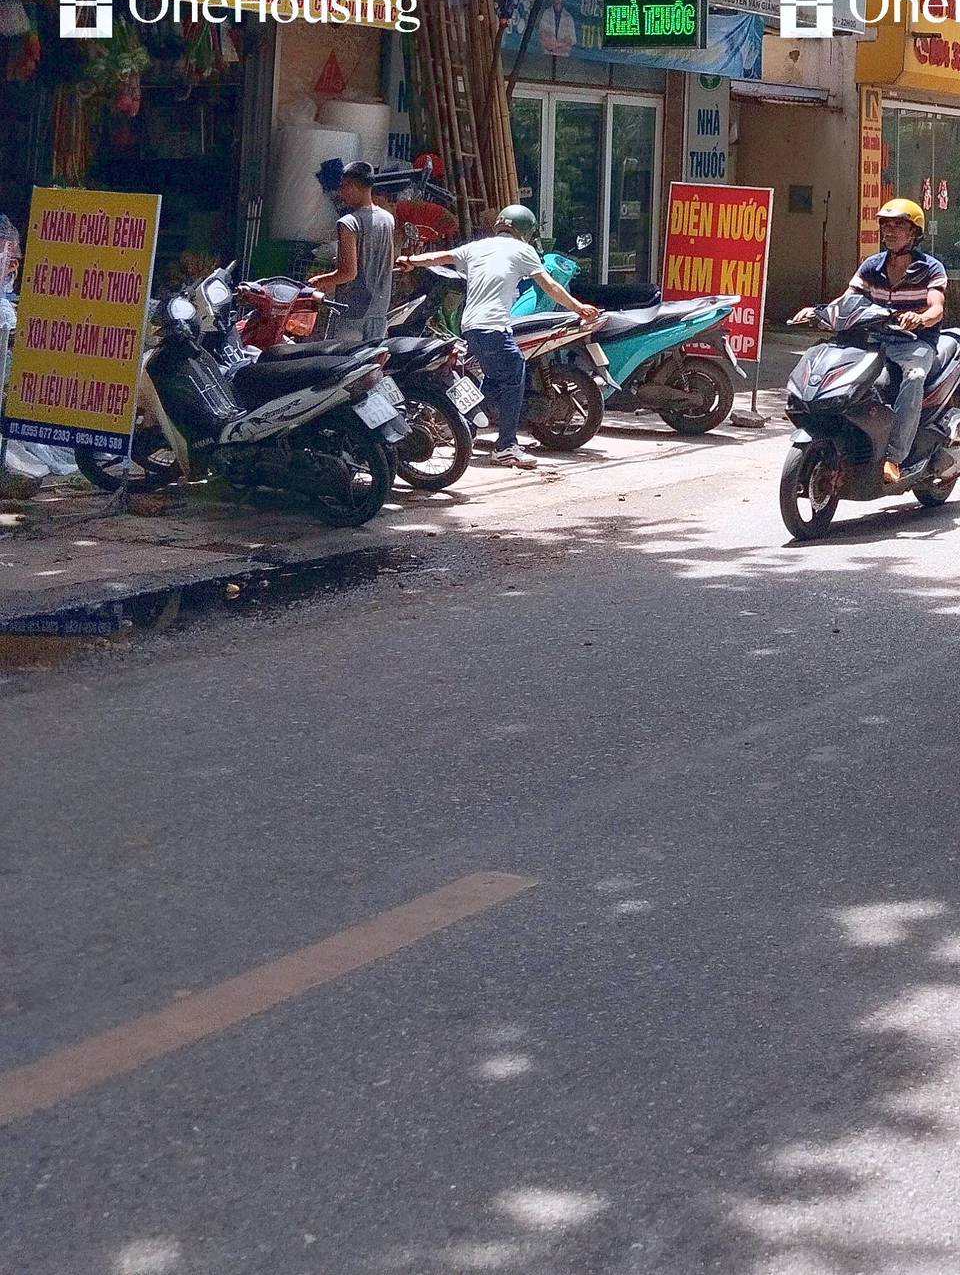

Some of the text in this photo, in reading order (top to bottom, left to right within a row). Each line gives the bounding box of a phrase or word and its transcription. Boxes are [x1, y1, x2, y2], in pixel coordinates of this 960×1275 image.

[606, 0, 640, 36] NHÀ
[697, 104, 720, 135] NHÀ
[689, 142, 725, 178] THUỐC
[40, 205, 147, 255] KHÁM CHỮA BỆNH
[671, 194, 767, 244] ĐIỆN NƯỚC
[32, 257, 142, 305] KÊ ĐƠN BỐC THUỐC
[667, 253, 762, 297] KIM KHÍ
[727, 307, 755, 325] NG
[26, 313, 137, 367] XOA BÓP BẤM HUYỆT
[20, 369, 130, 423] TRỊ LIỆU VÀ LÀM ĐẸP
